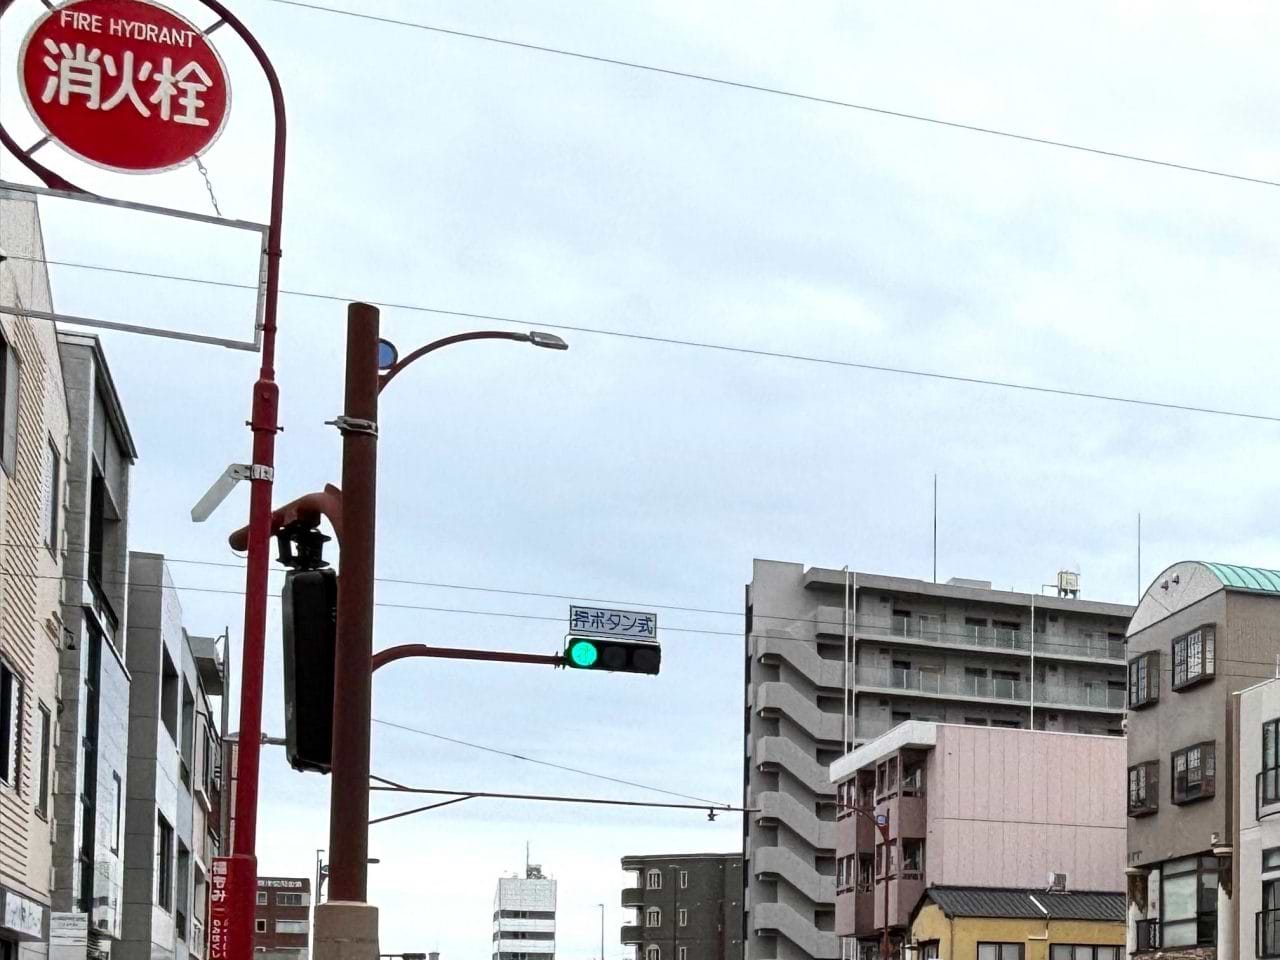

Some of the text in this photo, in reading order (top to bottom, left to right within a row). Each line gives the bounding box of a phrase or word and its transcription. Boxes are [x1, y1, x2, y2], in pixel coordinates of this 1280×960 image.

[61, 10, 196, 48] FIRE HYDRANT
[41, 38, 213, 127] 消火栓
[573, 610, 653, 635] 押ボタン式
